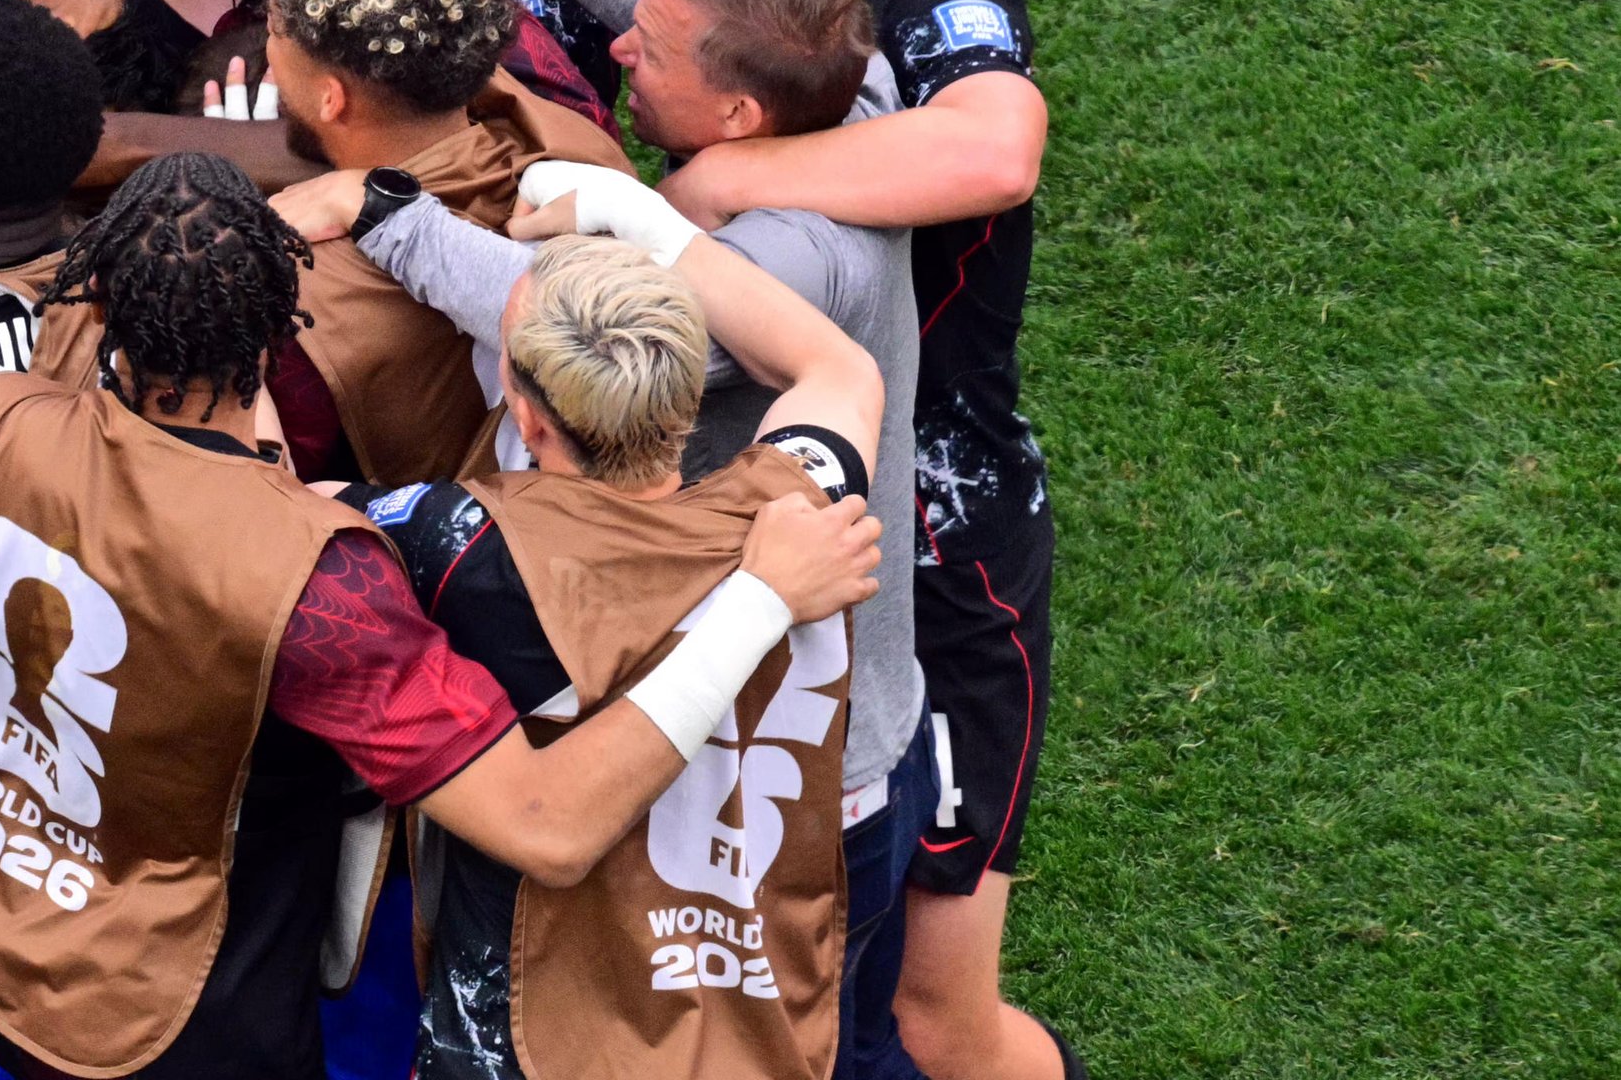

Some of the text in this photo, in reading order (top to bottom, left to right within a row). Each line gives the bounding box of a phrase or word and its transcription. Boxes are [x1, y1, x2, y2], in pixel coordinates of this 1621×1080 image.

[1, 715, 60, 795] FIFA
[45, 821, 104, 864] CUP
[709, 836, 750, 878] FI
[647, 906, 763, 950] WORLD
